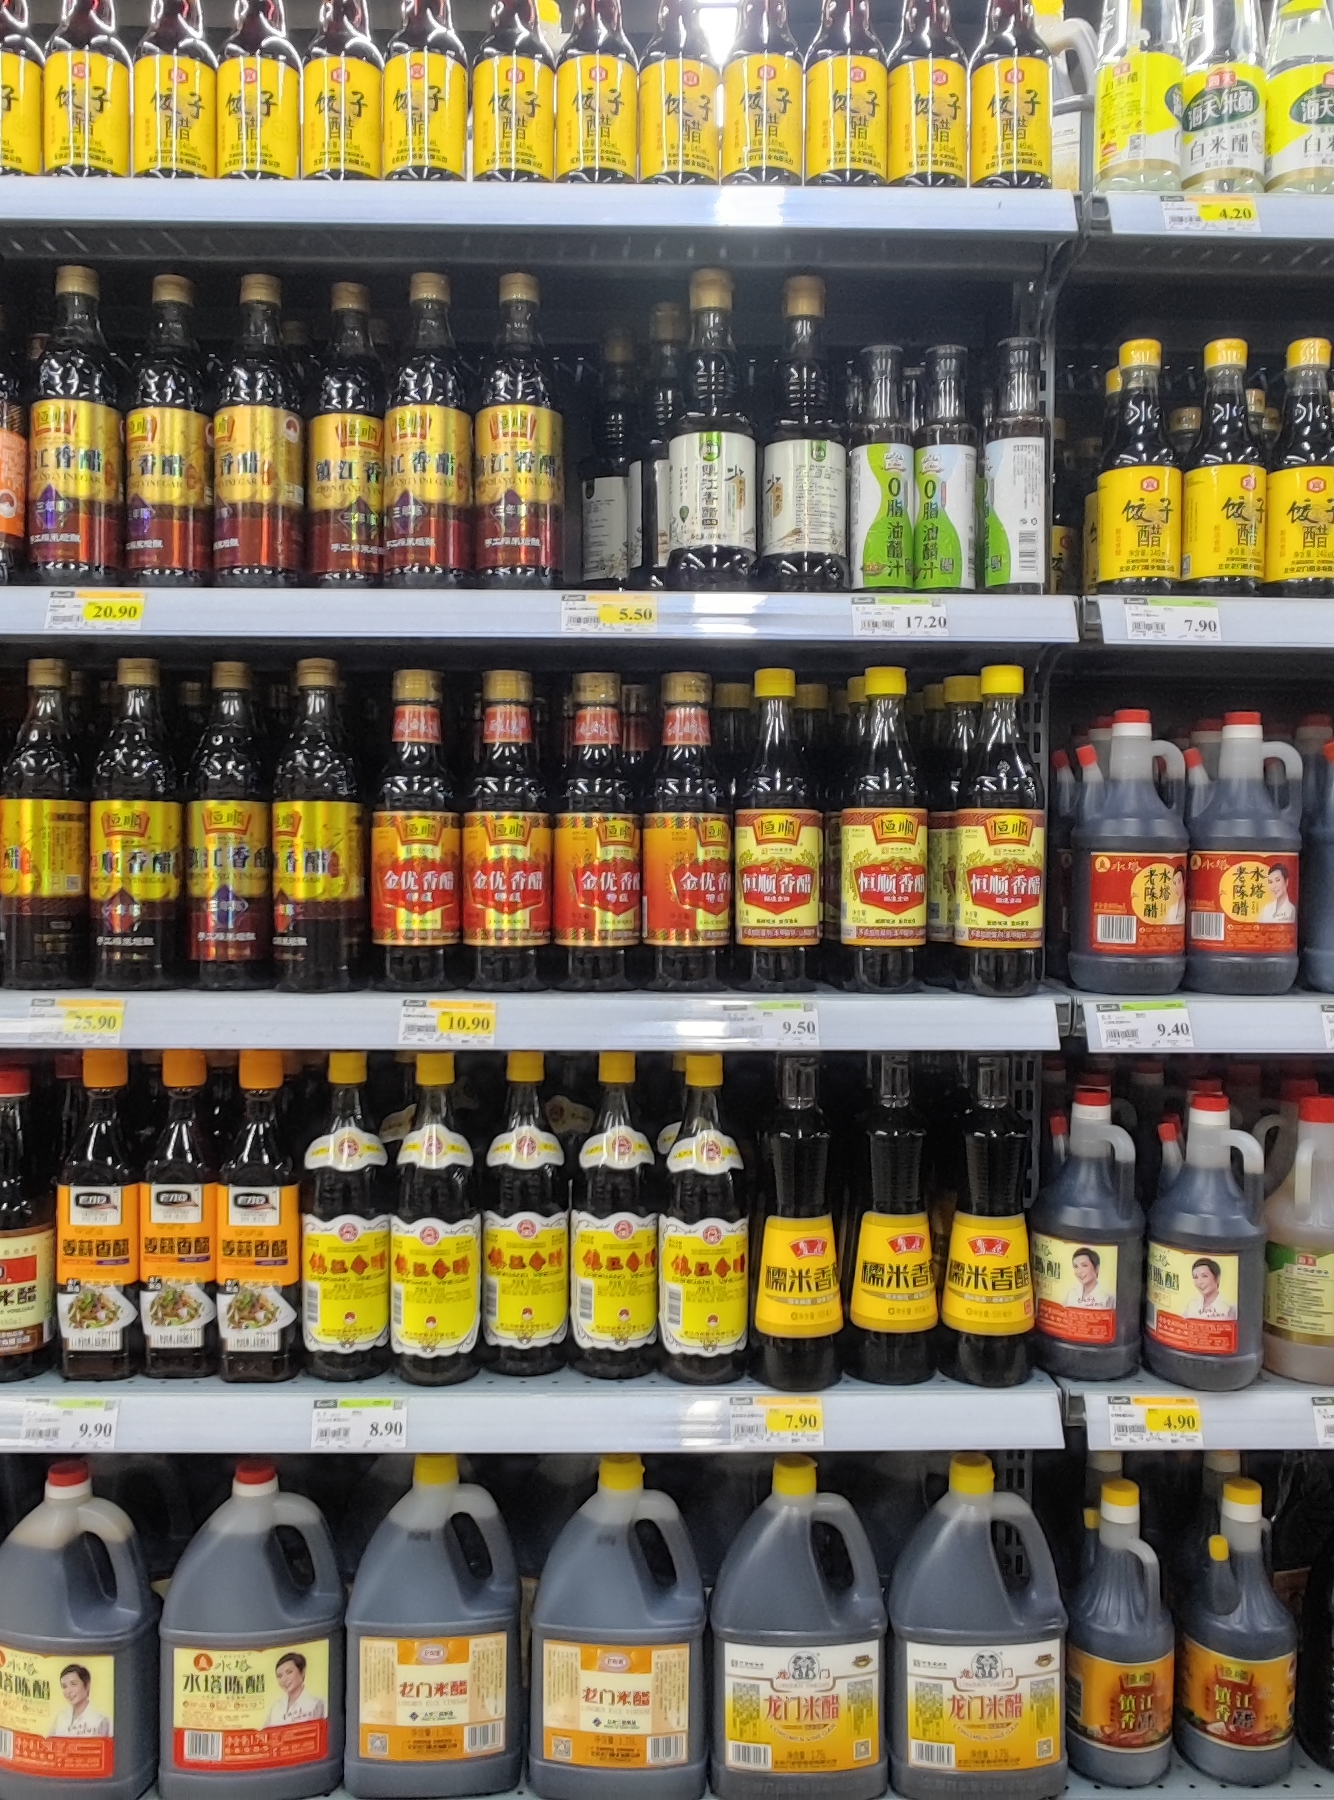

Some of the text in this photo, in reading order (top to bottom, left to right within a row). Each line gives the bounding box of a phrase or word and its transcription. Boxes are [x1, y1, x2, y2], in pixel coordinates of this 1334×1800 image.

[151, 90, 205, 119] 饺子
[666, 93, 714, 121] 饺子
[165, 116, 190, 141] 醋
[681, 118, 707, 142] 醋
[1219, 207, 1253, 221] 4.20
[1122, 497, 1174, 526] 饺子
[885, 476, 904, 578] 0脂油醋汁
[921, 478, 939, 579] 0脂油醋汁
[1137, 524, 1162, 548] 醋
[92, 605, 137, 619] 20.90
[619, 608, 652, 621] 5.50
[906, 615, 947, 629] 17.20
[1184, 619, 1217, 634] 7.90
[759, 817, 799, 838] 恒顺
[877, 817, 916, 837] 恒顺
[992, 817, 1030, 837] 恒顺
[384, 870, 454, 892] 金优香醋
[473, 870, 544, 892] 金优香醋
[743, 874, 811, 896] 恒顺香醋
[970, 873, 1040, 896] 恒顺香醋
[73, 1015, 116, 1030] 25.90
[447, 1017, 490, 1032] 10.90
[782, 1021, 816, 1035] 9.50
[1157, 1022, 1189, 1037] 9.40
[767, 1262, 838, 1294] 糯米香
[79, 1422, 112, 1437] 9.90
[369, 1421, 402, 1436] 8.90
[784, 1414, 817, 1429] 7.90
[1163, 1415, 1195, 1430] 4.90
[183, 1673, 266, 1695] 水塔陈醋
[764, 1693, 840, 1721] 龙门米醋
[946, 1693, 1023, 1721] 龙门米醋
